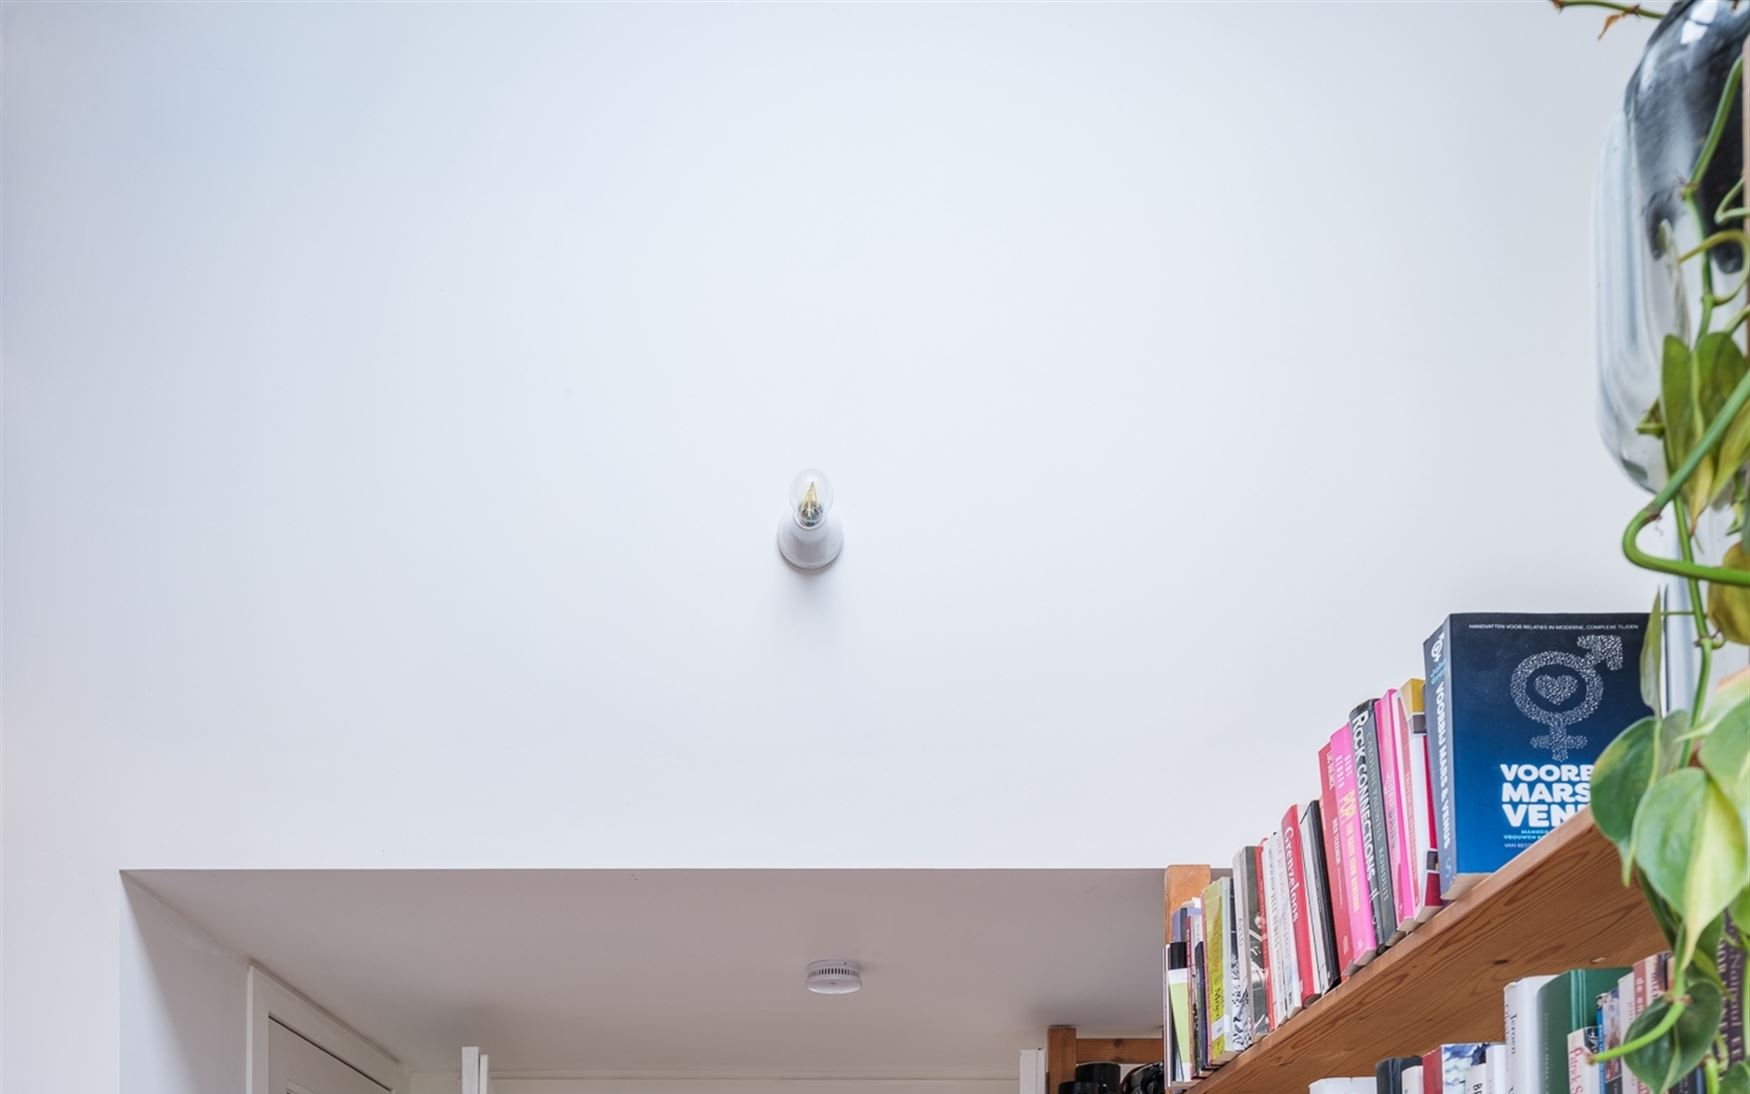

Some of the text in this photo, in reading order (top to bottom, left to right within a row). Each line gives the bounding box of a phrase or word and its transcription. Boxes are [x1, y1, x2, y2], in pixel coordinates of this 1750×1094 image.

[1435, 682, 1447, 745] VOORBIJ
[1438, 745, 1449, 787] MARS
[1500, 764, 1594, 782] VOORB
[1501, 783, 1592, 803] MARS
[1356, 763, 1376, 882] CONNECTIONS
[1441, 801, 1451, 850] VENUS
[1284, 827, 1300, 923] Grenzeloos
[1570, 1048, 1584, 1084] Patrick
